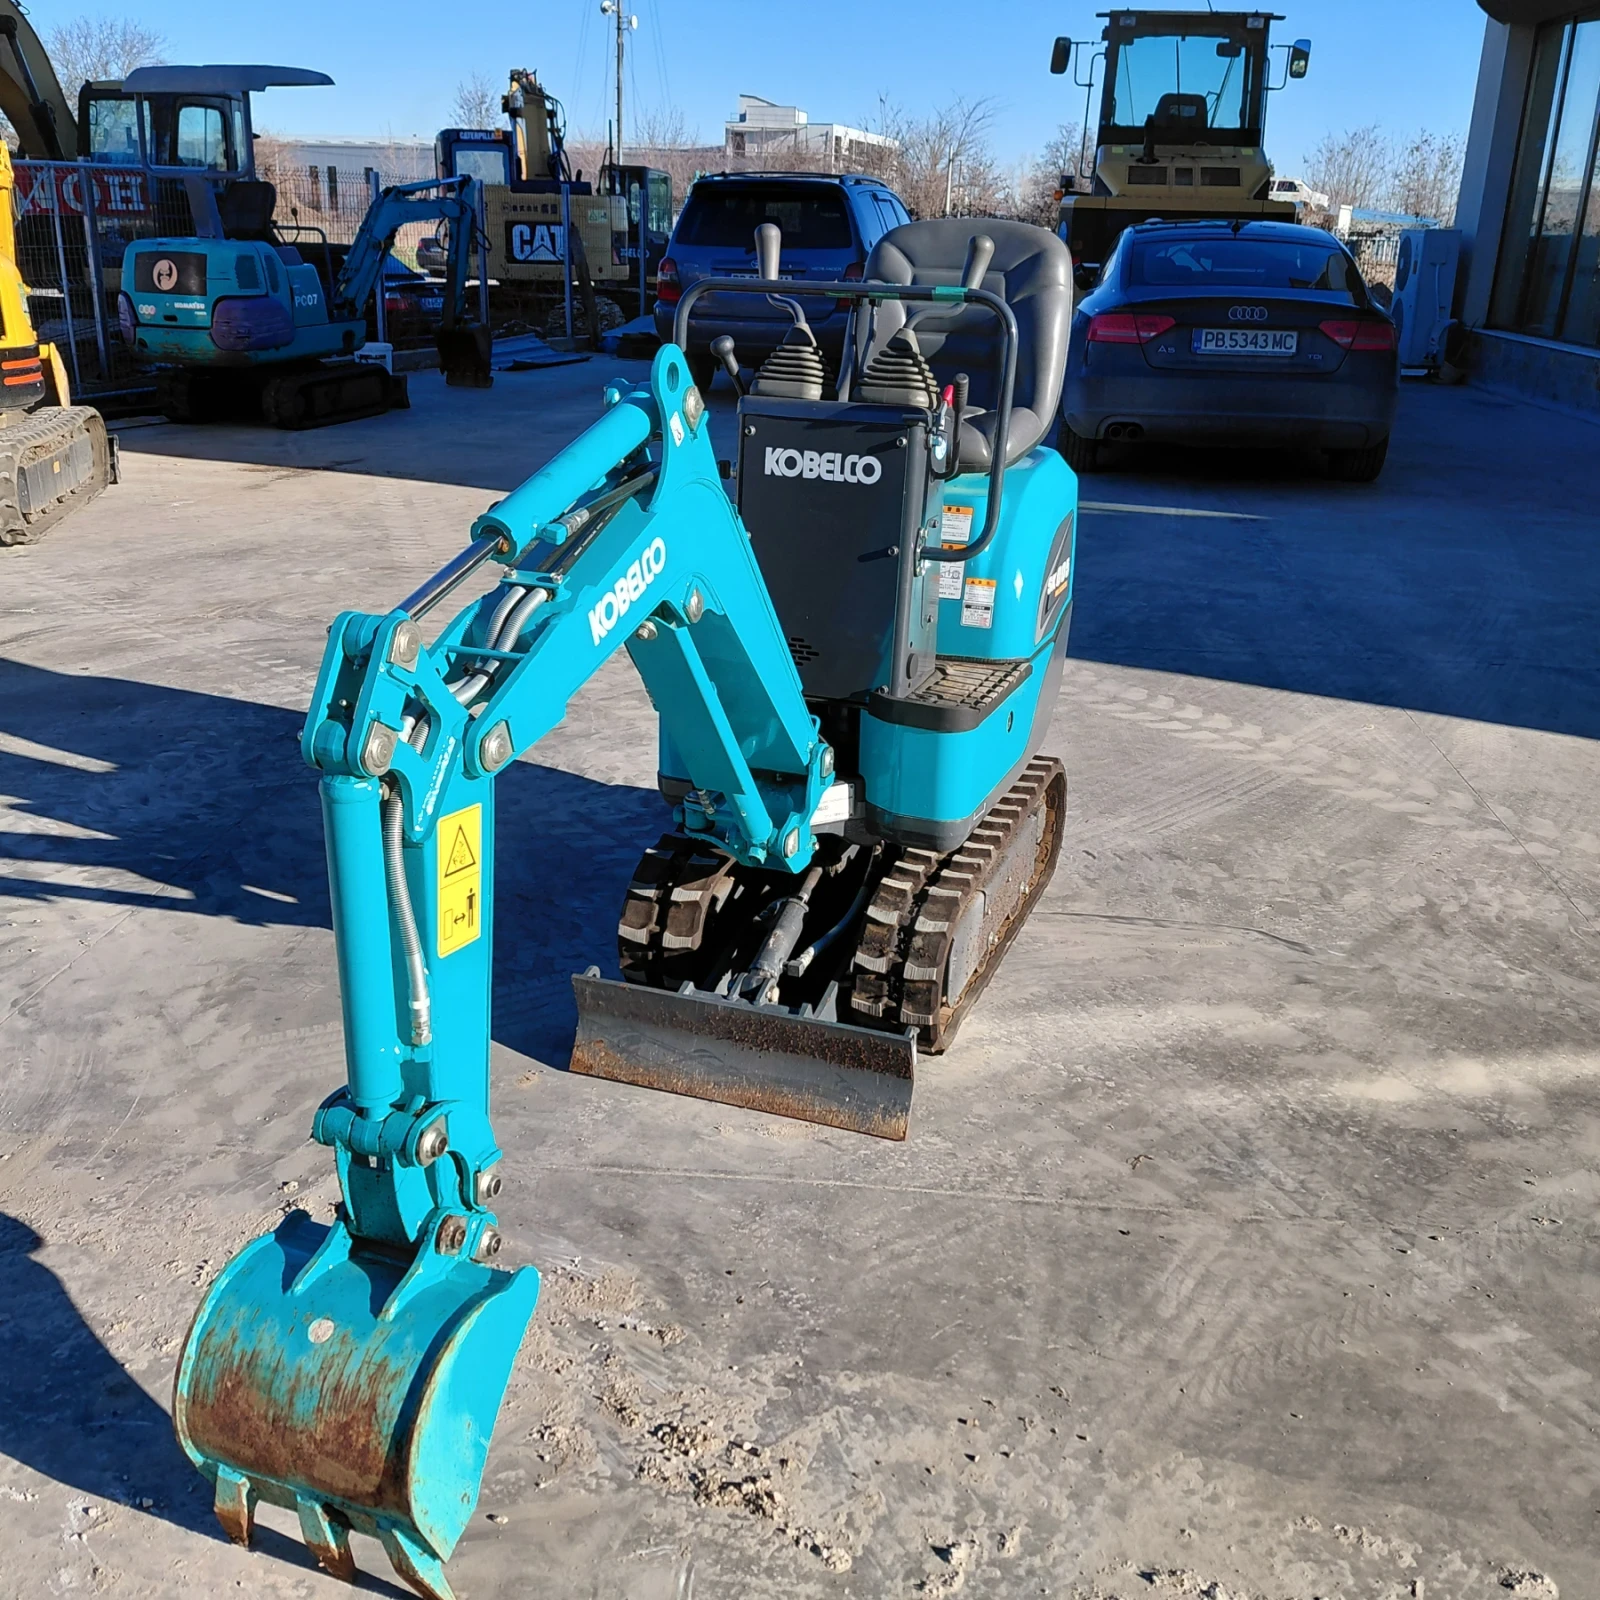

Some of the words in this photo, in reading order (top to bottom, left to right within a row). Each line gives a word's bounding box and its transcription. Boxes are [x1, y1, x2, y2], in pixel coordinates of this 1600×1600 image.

[459, 131, 502, 140] CATERPILLA
[512, 224, 564, 260] CAT
[174, 301, 205, 310] KOMATSU
[294, 293, 318, 307] PC07
[1158, 345, 1176, 354] A5
[764, 446, 882, 485] KOBELCO
[587, 536, 667, 647] KOBELCO
